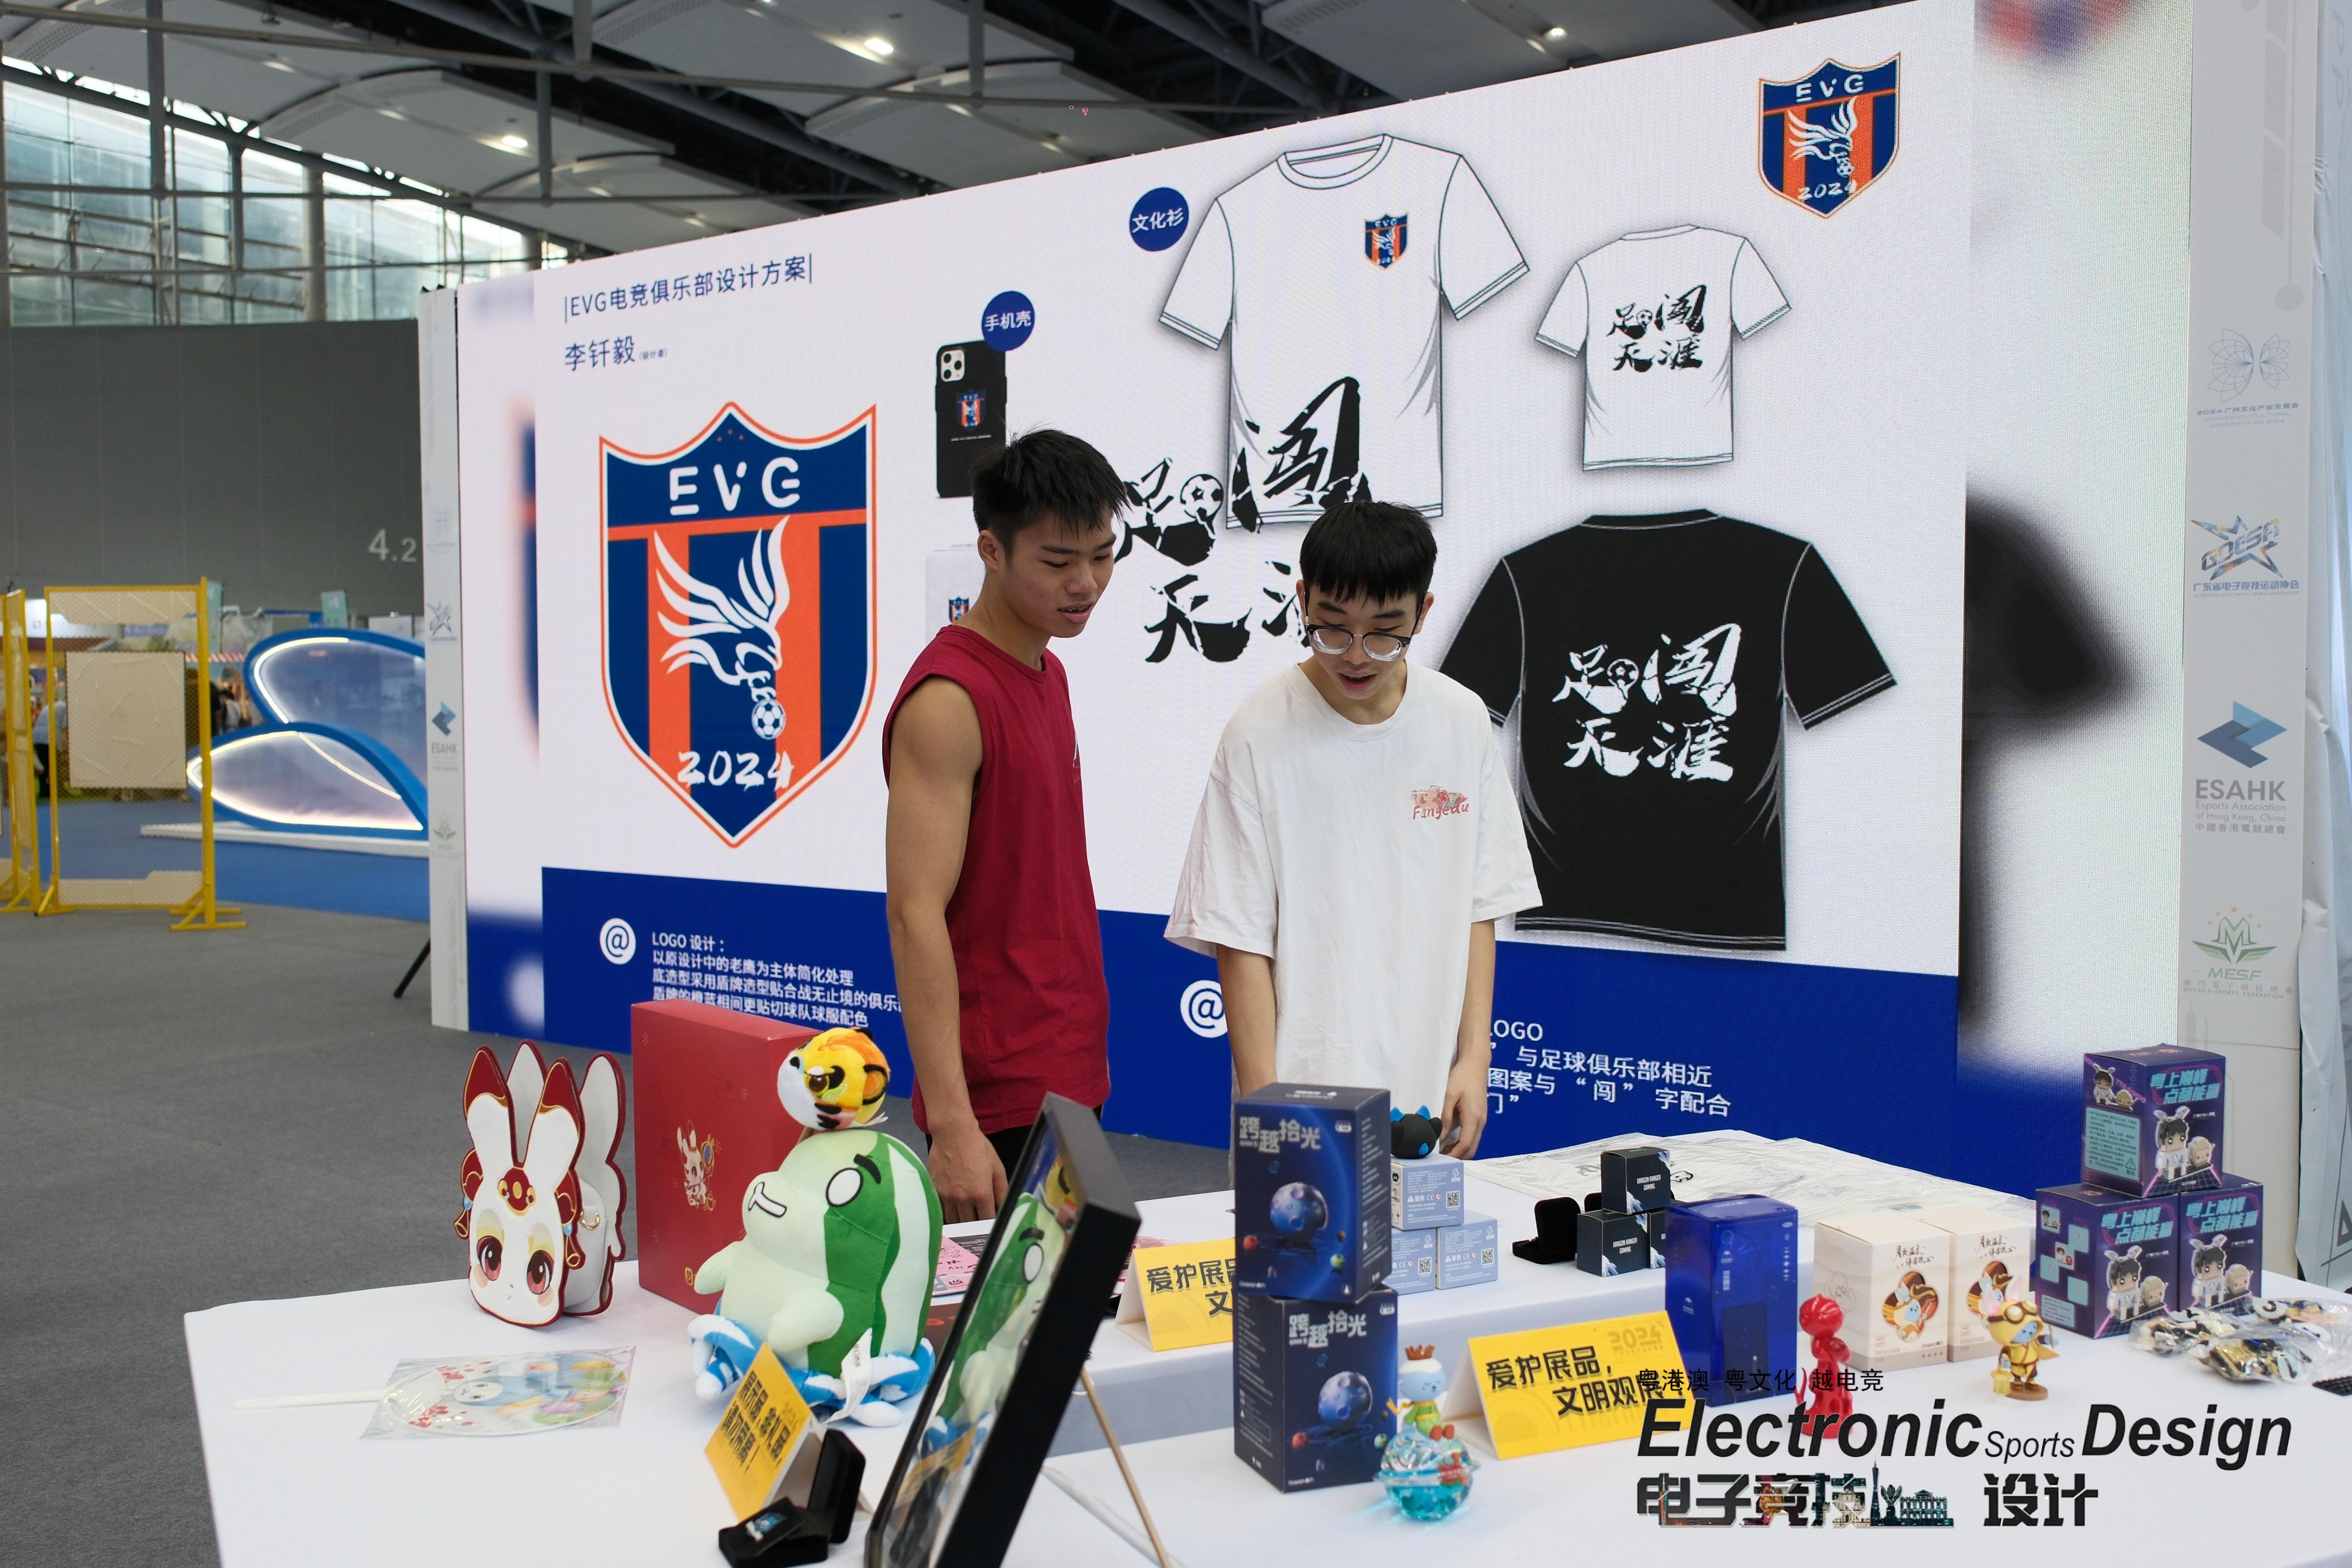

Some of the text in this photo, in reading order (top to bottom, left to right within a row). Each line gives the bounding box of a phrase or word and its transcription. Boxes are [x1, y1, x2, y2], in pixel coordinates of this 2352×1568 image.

[1796, 74, 1864, 103] EVG
[1798, 180, 1857, 200] 2024
[1132, 207, 1184, 234] 文化衫
[984, 310, 1032, 332] 手机壳
[564, 336, 636, 371] 李钎毅
[670, 457, 800, 516] EVG
[368, 529, 417, 563] 4.2
[2193, 580, 2299, 592] 广东省电子竞技运动协会
[1564, 715, 1734, 782] 天涯
[677, 751, 795, 793] 2024
[2196, 779, 2286, 801] ESAHK
[1413, 803, 1470, 820] Fangedu
[2196, 801, 2286, 811] Esports Association
[2196, 812, 2203, 820] of
[2207, 812, 2229, 822] Hong
[2260, 813, 2286, 822] China
[652, 931, 687, 949] LOGO
[653, 949, 854, 987] 以原设计中的老鹰为主体简化处理
[2207, 967, 2263, 980] MESF
[652, 967, 902, 1013] 底造型采用盾牌造型贴合战无止境的俱乐
[1490, 1019, 1543, 1042] OGO
[1239, 1115, 1321, 1154] 跨越拾光
[1612, 1239, 1625, 1248] DRAGON
[1619, 1246, 1631, 1254] GAMING
[1289, 1310, 1367, 1348] 跨越拾光
